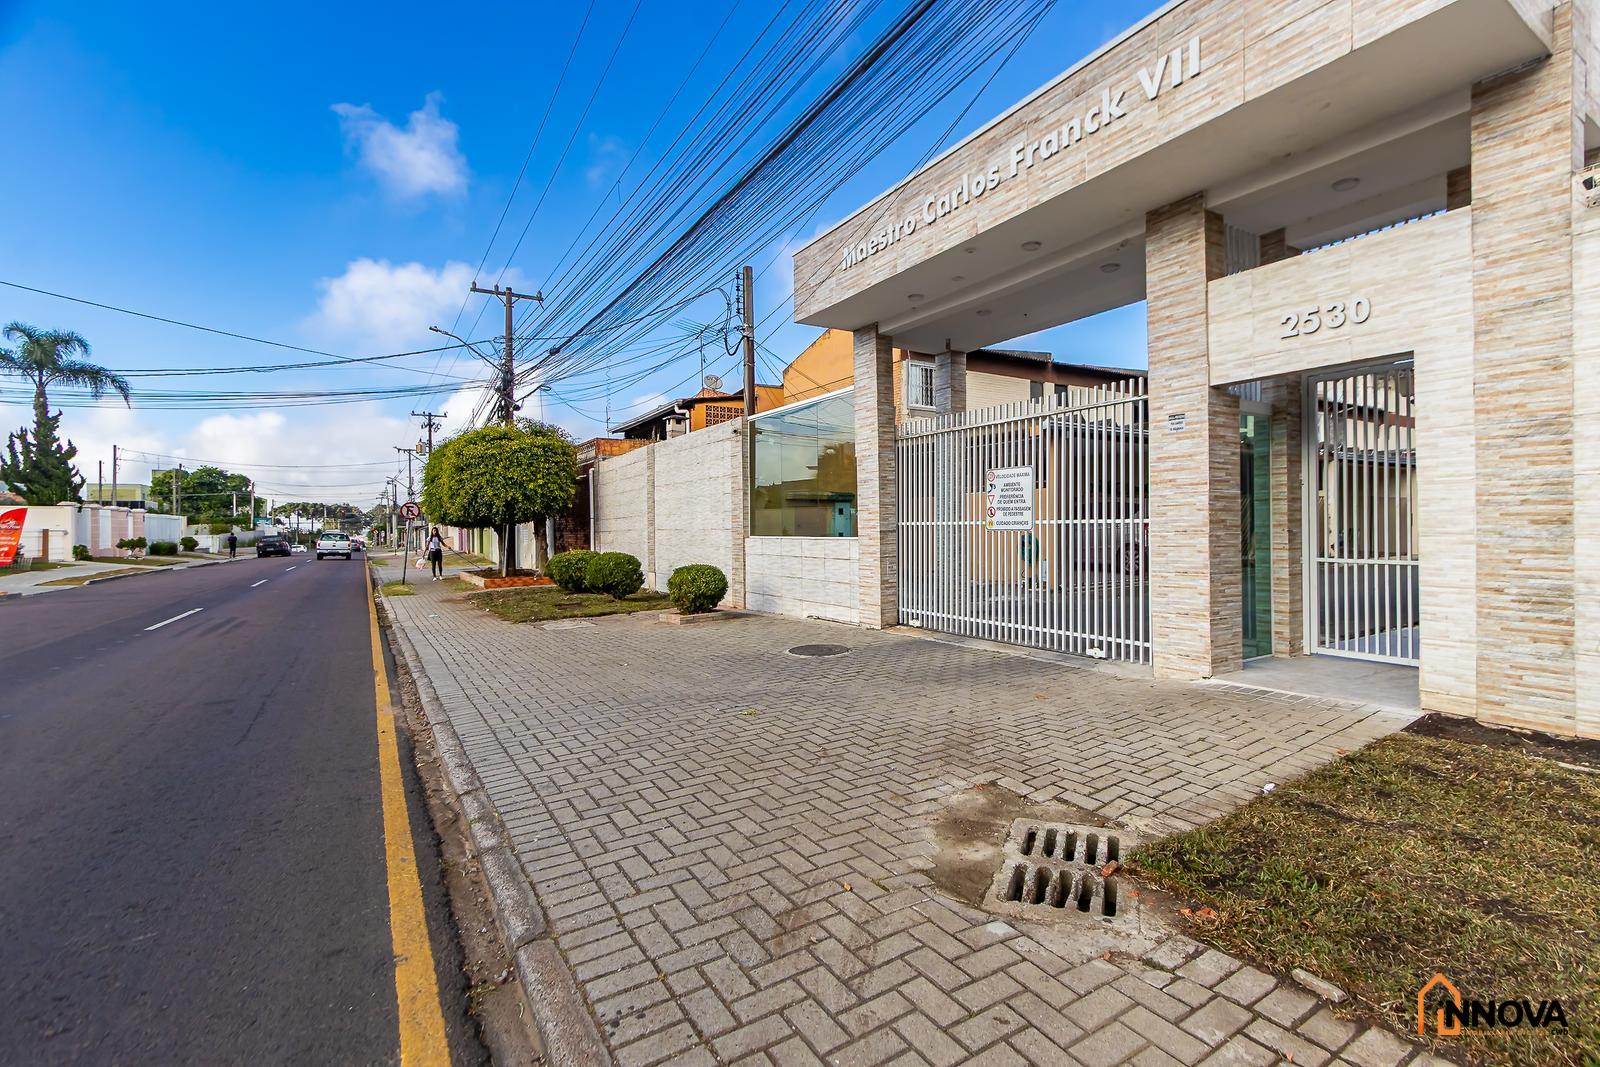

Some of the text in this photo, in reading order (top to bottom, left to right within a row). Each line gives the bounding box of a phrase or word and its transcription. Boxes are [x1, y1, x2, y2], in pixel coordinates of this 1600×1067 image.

[840, 35, 1202, 271] Maestro Carlos Franck VII
[1280, 296, 1371, 340] 2530
